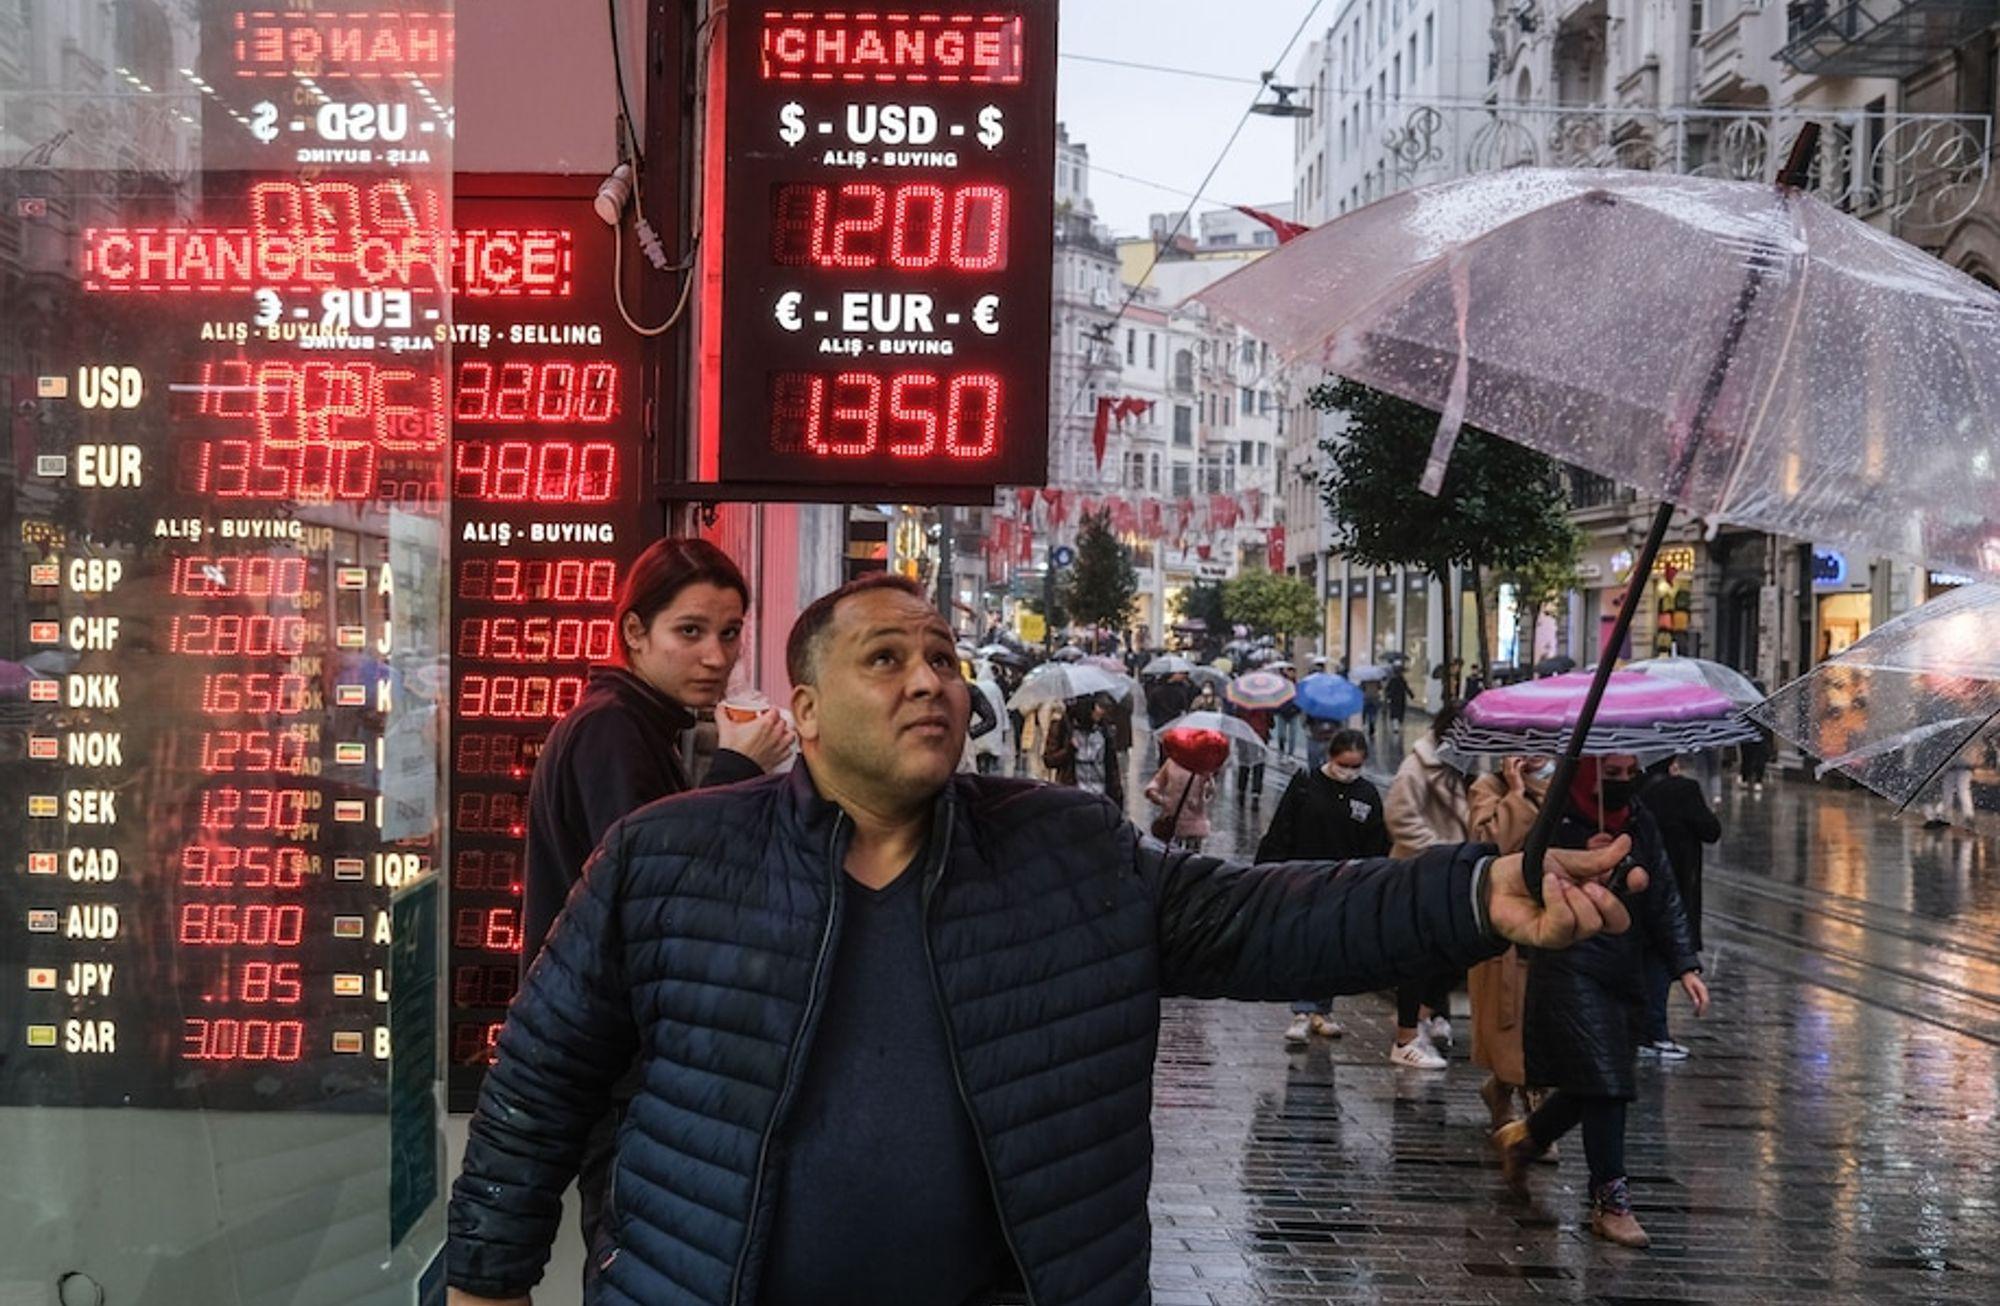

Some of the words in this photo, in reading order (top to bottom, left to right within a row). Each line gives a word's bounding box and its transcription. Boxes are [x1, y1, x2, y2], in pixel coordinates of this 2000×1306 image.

[776, 30, 1001, 66] CHANGE
[779, 102, 806, 146] $
[846, 105, 938, 145] USD
[977, 105, 1003, 150] $
[823, 151, 866, 168] ALIŞ
[884, 152, 957, 167] BUYING
[100, 235, 336, 281] CHANGE
[356, 237, 557, 284] OFFICE
[775, 292, 802, 331] €
[842, 294, 933, 332] EUR
[972, 296, 999, 334] €
[201, 322, 248, 345] ALIŞ
[267, 322, 350, 343] BUYING
[435, 324, 491, 348] SATIŞ
[510, 325, 602, 345] SELLING
[819, 339, 863, 357] ALIŞ
[879, 340, 953, 356] BUYING
[78, 366, 144, 409] USD
[77, 445, 143, 488] EUR
[155, 519, 202, 542] ALIŞ
[221, 520, 301, 538] BUYING
[463, 522, 511, 546] ALIŞ
[531, 523, 614, 543] BUYING
[69, 559, 122, 592] GBP
[68, 616, 120, 650] CHF
[68, 674, 120, 708] DKK
[68, 732, 122, 766] NOK
[67, 789, 116, 824] SEK
[67, 847, 119, 881] CAD
[67, 905, 119, 939] AUD
[66, 963, 115, 997] JPY
[65, 1020, 116, 1053] SAR
